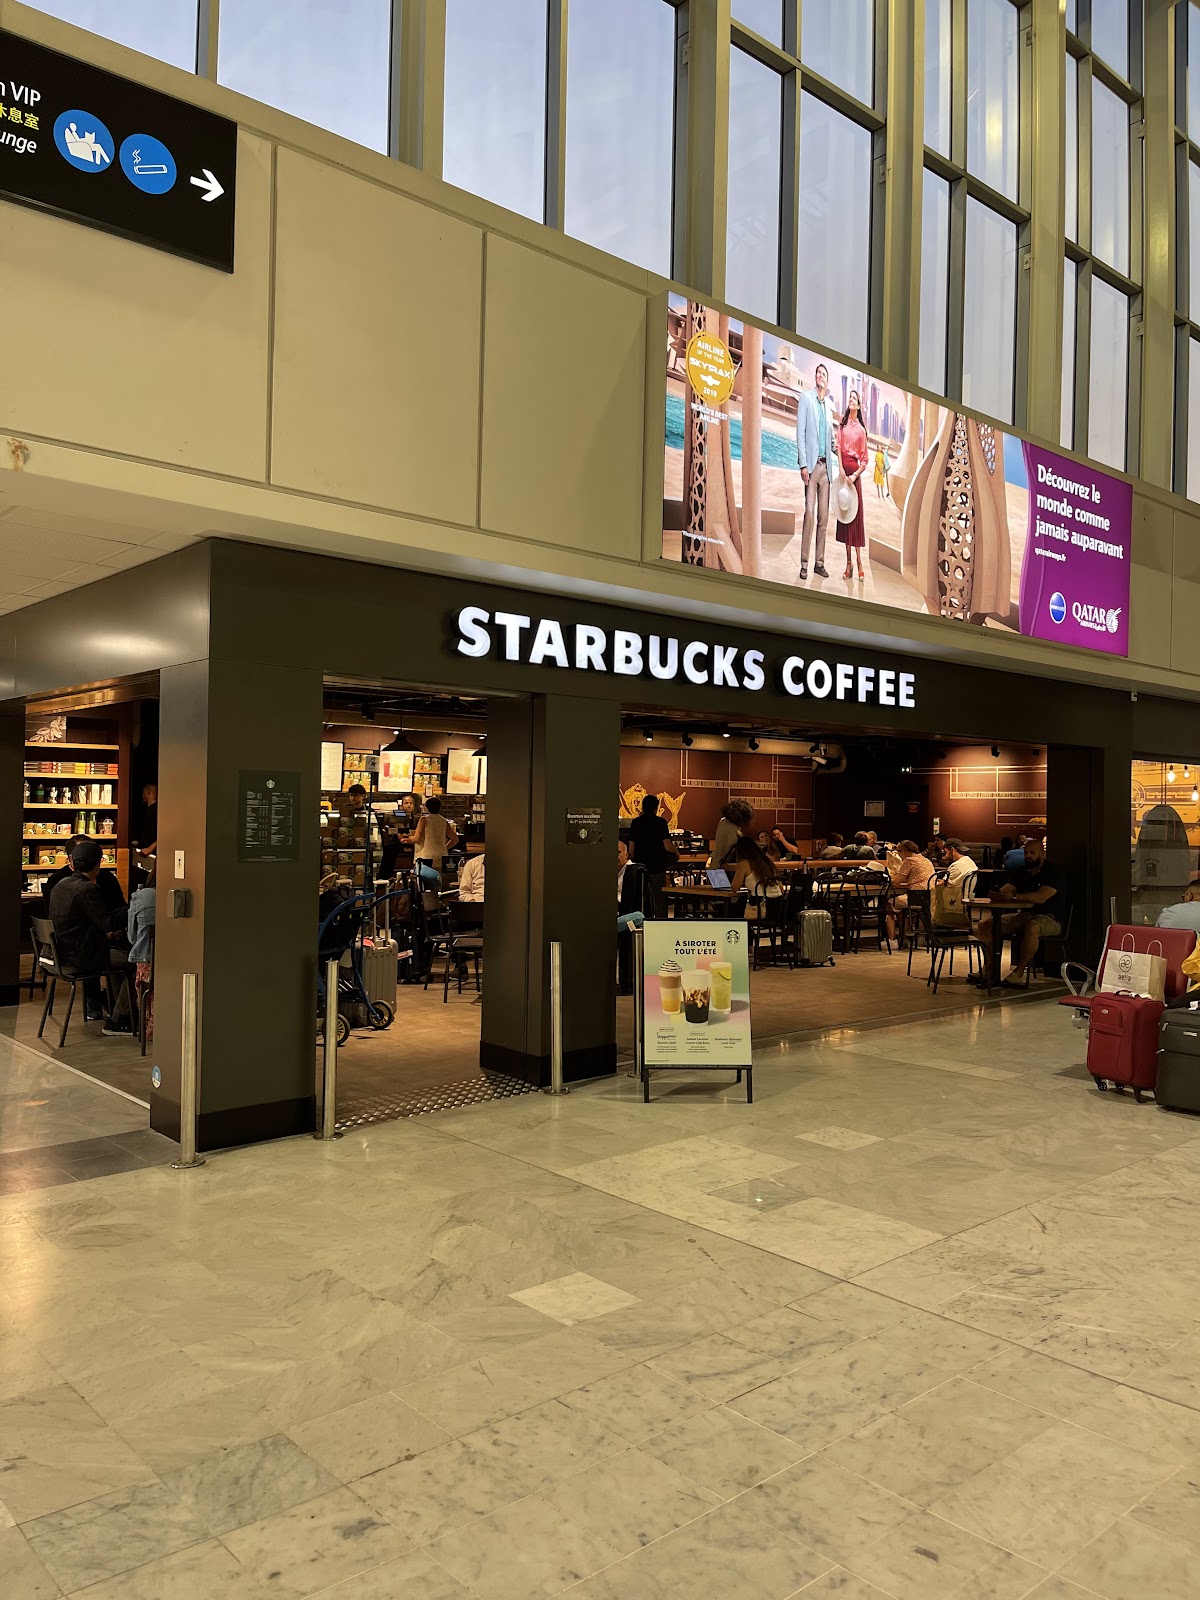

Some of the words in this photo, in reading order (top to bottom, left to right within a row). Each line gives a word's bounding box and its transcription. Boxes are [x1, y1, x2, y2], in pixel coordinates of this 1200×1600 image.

[10, 81, 41, 106] VIP
[697, 340, 724, 356] AIRLINE
[690, 357, 730, 378] SKYTRAX
[713, 356, 724, 364] YEAR
[703, 387, 717, 397] 2019
[691, 403, 714, 415] WORLD'S
[715, 411, 728, 420] BEST
[700, 414, 719, 425] AIRLINE
[1037, 464, 1090, 500] Découvrez
[1091, 484, 1101, 504] le
[1036, 494, 1073, 518] monde
[1074, 508, 1110, 531] comme
[1035, 515, 1069, 542] jamais
[1071, 531, 1124, 559] auparavant
[1072, 601, 1106, 625] QATAR
[456, 606, 765, 691] STARBUCKS
[782, 655, 916, 708] COFFEE
[675, 938, 681, 947] À
[697, 947, 717, 955] L'ÉTÉ
